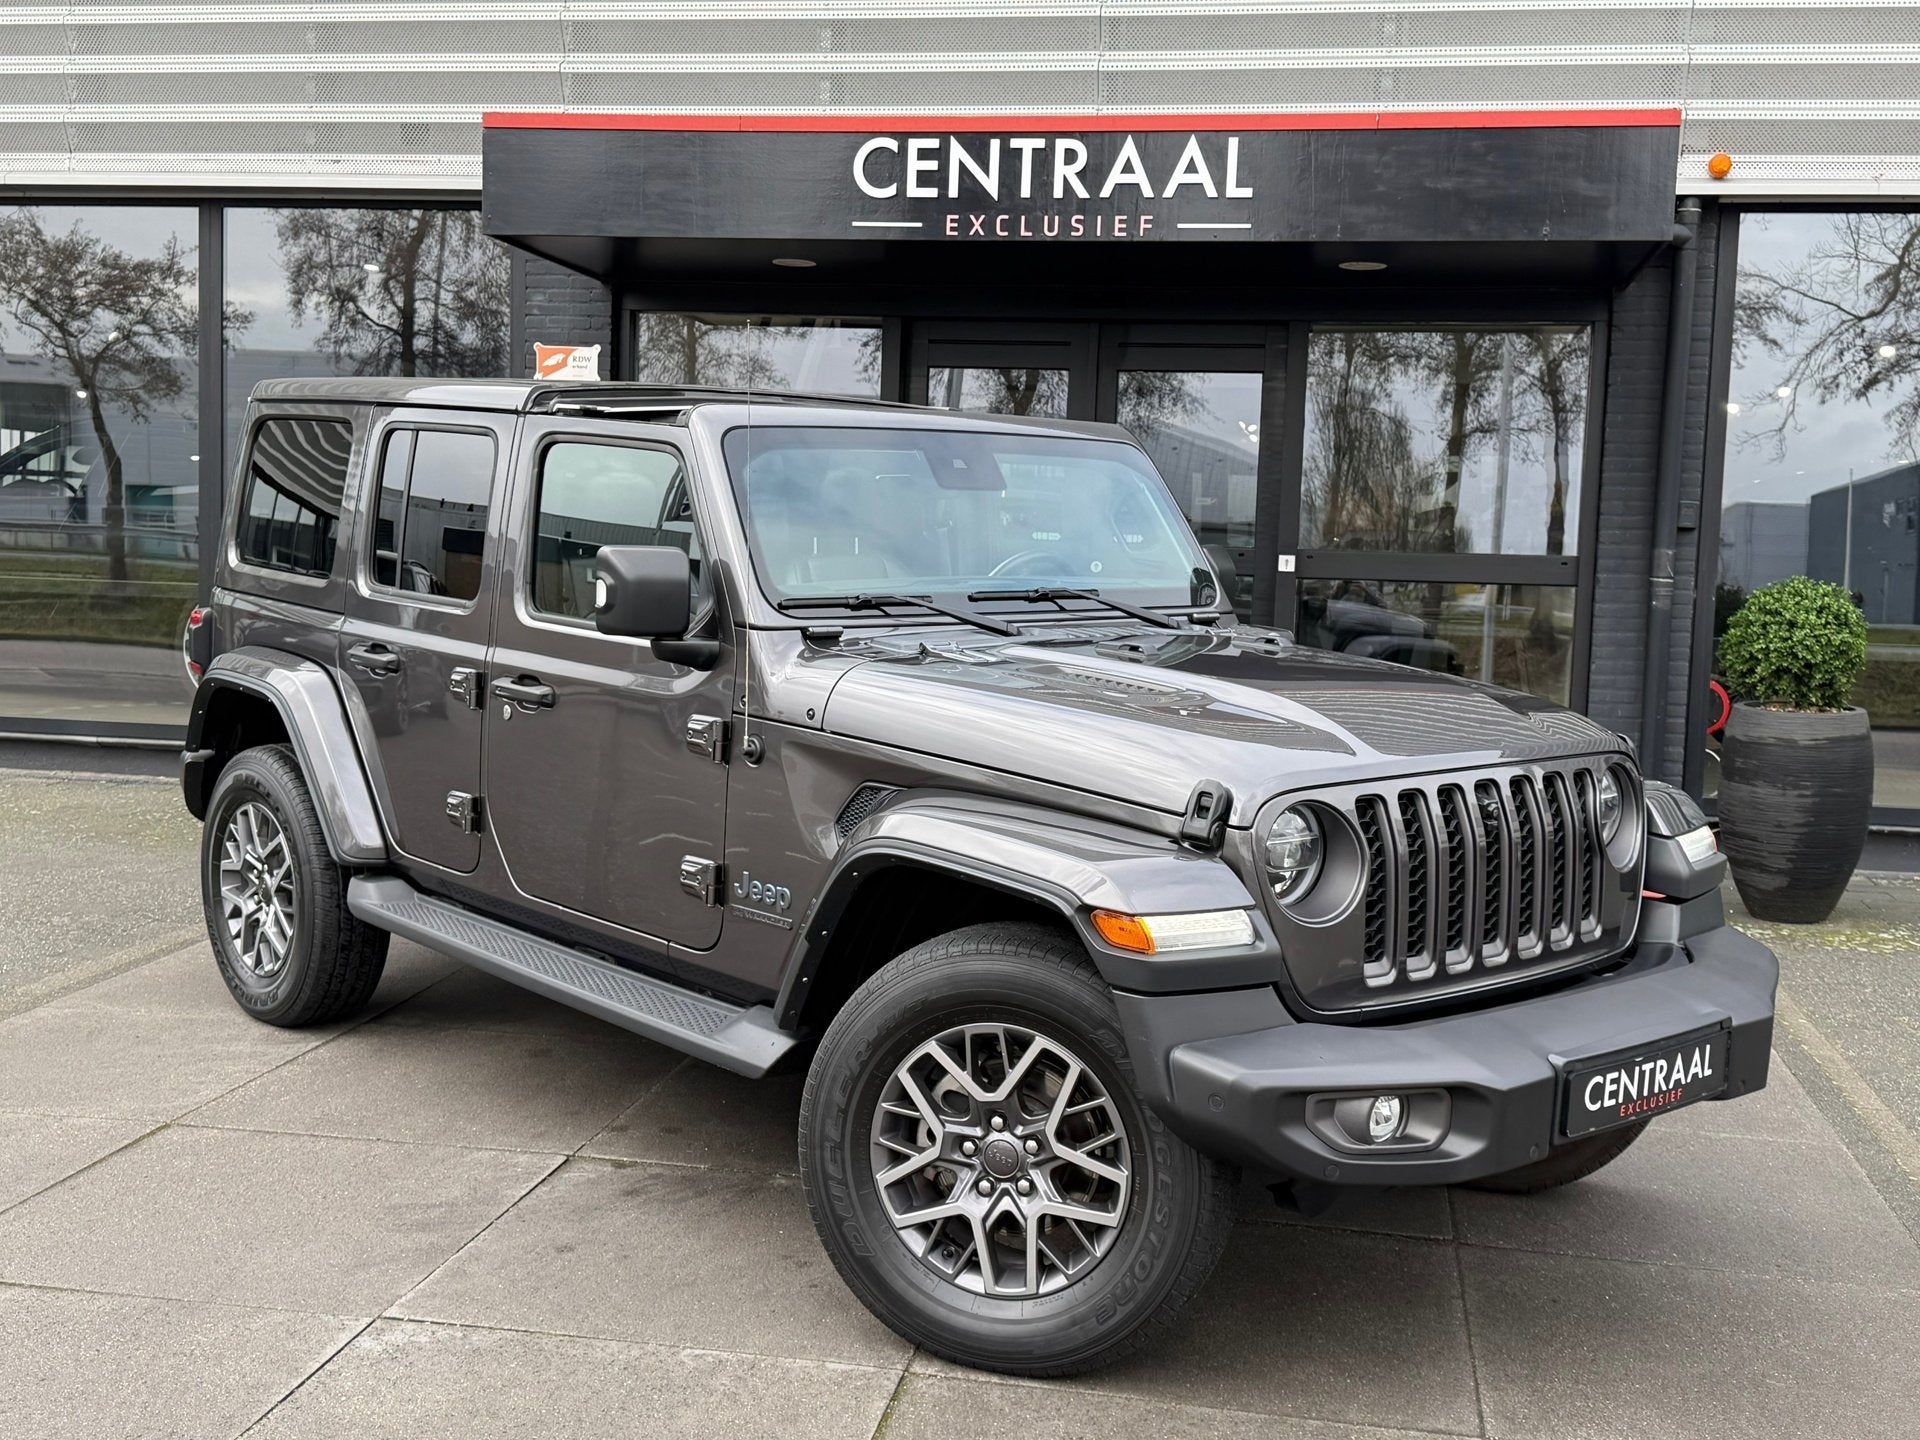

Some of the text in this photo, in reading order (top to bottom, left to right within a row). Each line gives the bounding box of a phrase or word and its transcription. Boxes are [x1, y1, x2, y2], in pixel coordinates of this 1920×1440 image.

[852, 134, 1254, 202] CENTRAAL
[945, 214, 1154, 237] EXCLUSIEF
[572, 355, 592, 363] RDW
[733, 870, 791, 914] Jeep
[1584, 1044, 1713, 1112] CENTRAAL
[1620, 1088, 1684, 1117] EXCLUSIEF
